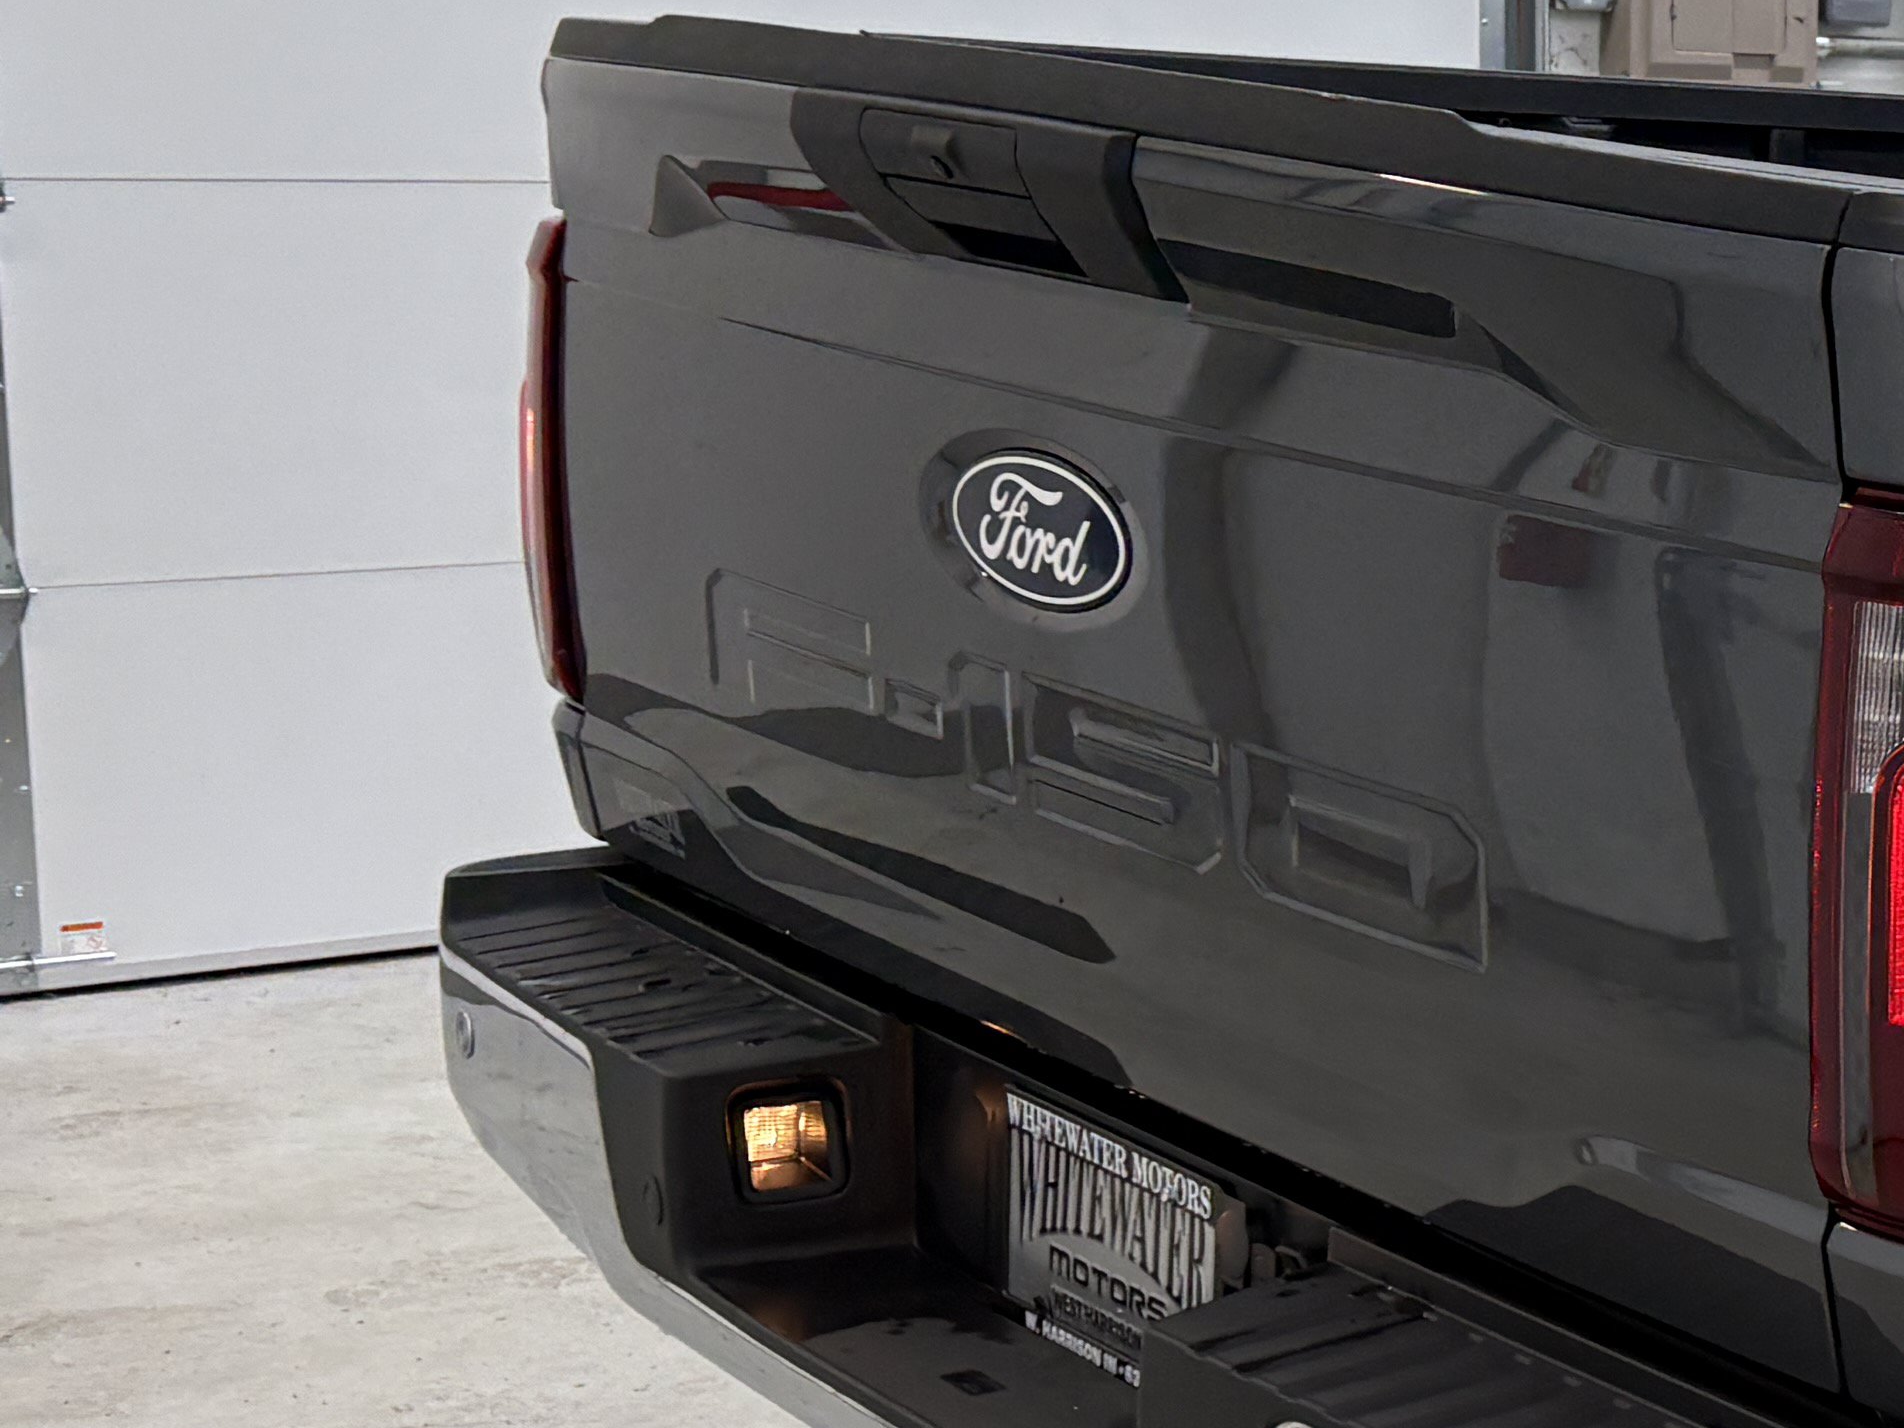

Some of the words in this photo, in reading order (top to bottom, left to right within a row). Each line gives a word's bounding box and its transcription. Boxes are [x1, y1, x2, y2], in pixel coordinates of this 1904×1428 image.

[978, 471, 1093, 587] Ford
[705, 568, 1487, 974] F-150
[1006, 1091, 1128, 1180] WHITEWATER
[1131, 1150, 1213, 1220] MOTORS
[1049, 1243, 1169, 1322] MOTORS
